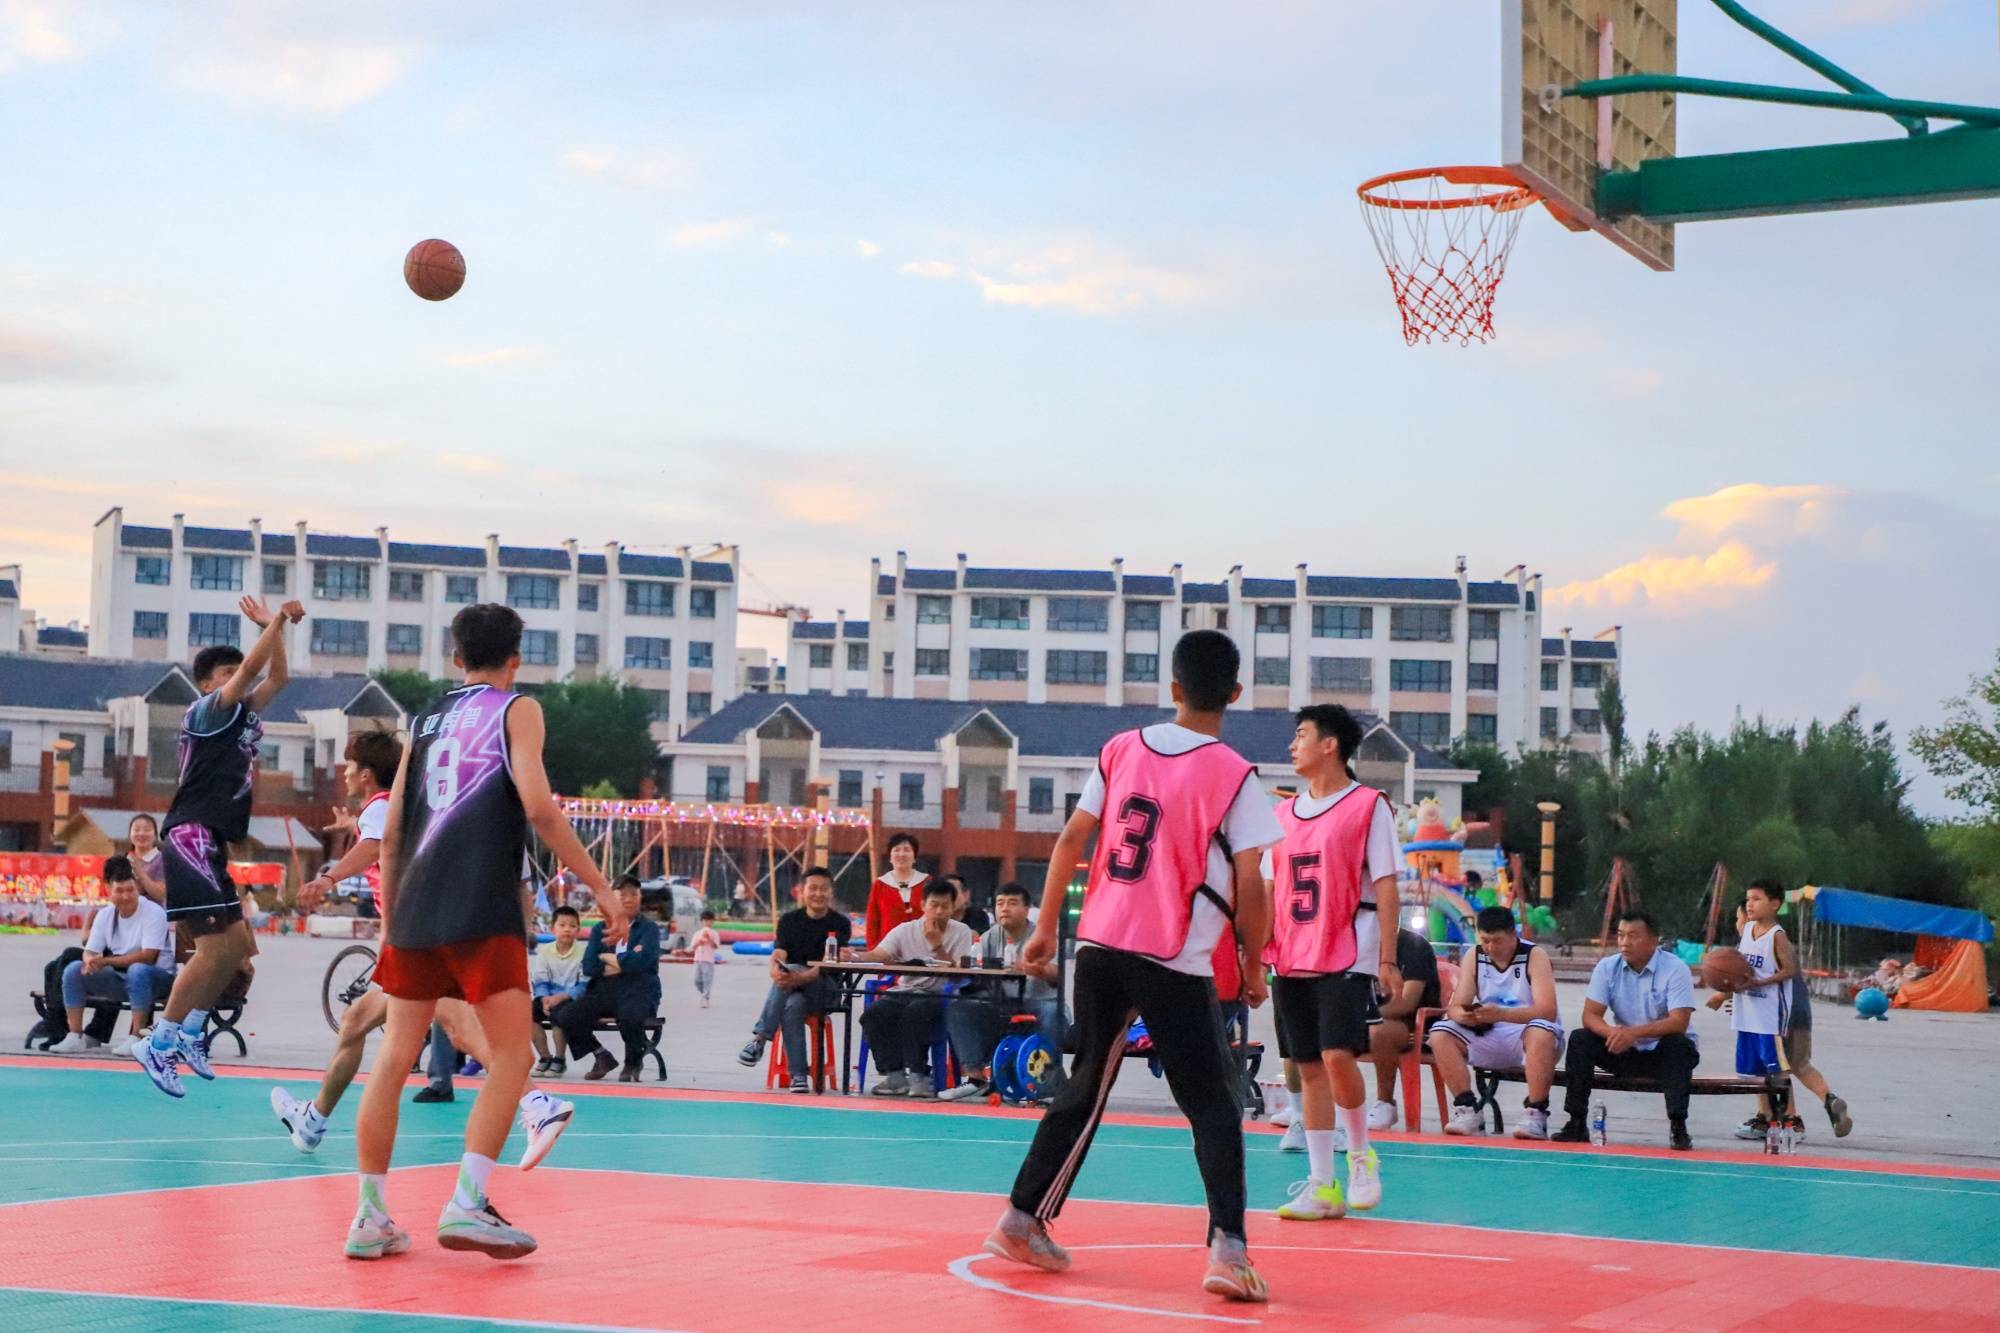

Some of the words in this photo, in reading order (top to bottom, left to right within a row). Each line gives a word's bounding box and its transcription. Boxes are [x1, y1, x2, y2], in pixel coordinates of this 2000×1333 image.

[427, 736, 460, 811] 8
[1105, 792, 1163, 884] 3
[1289, 851, 1321, 925] 5
[1514, 967, 1521, 979] 6
